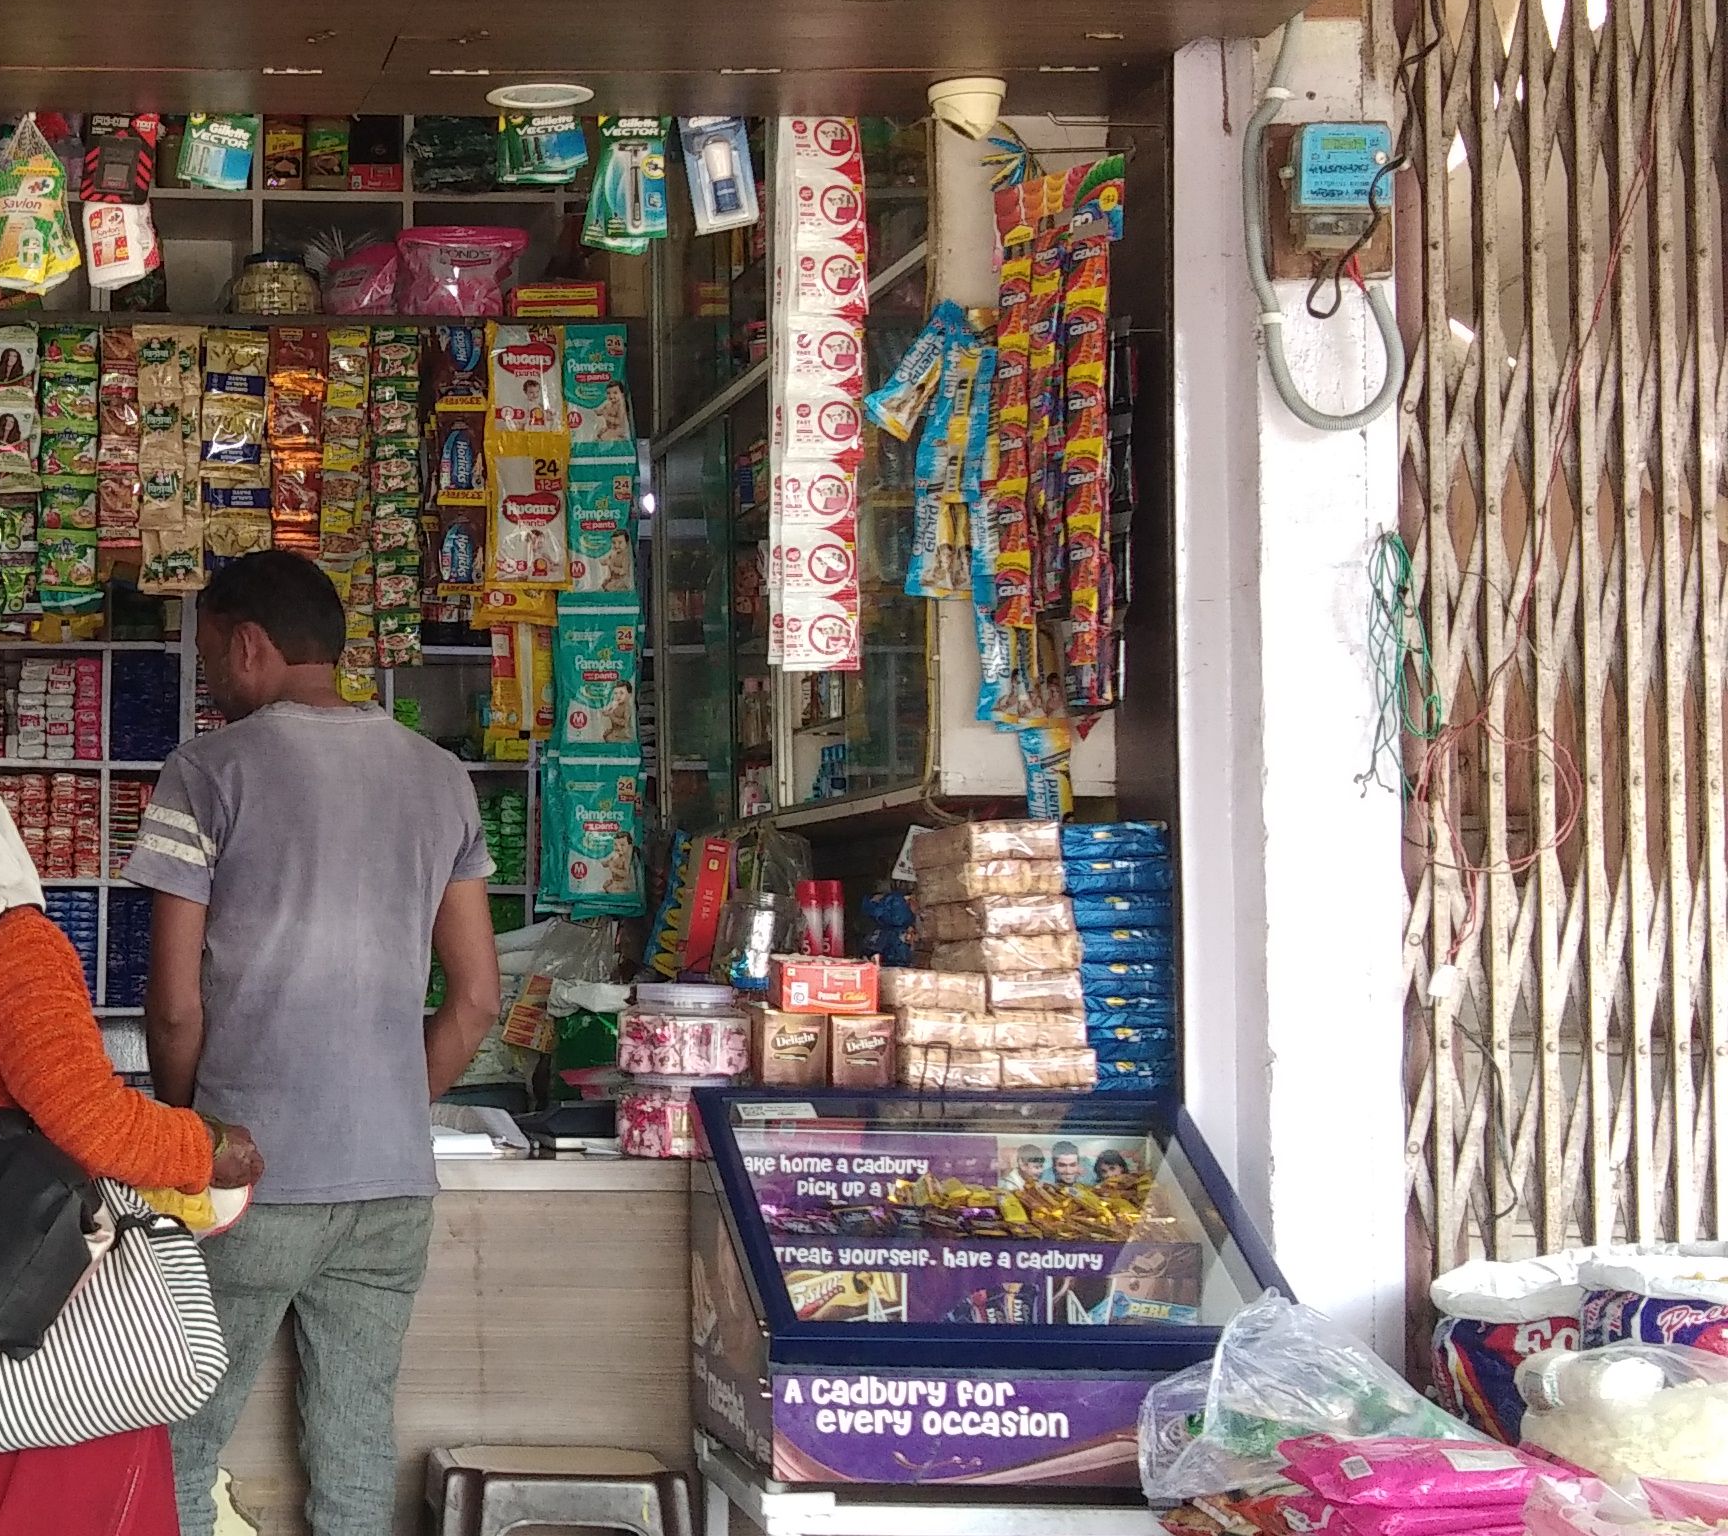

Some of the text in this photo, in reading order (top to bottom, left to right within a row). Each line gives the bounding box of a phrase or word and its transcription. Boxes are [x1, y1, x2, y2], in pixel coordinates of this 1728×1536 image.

[209, 123, 251, 140] Gillette
[517, 122, 576, 136] VECTOR
[603, 125, 660, 137] VECTOR
[191, 128, 249, 150] VECTOR
[1, 197, 43, 210] Savlon
[1070, 322, 1097, 335] GEMS
[502, 352, 552, 366] HUGGIES
[567, 358, 614, 373] Pampers
[896, 333, 936, 383] Gillette
[456, 441, 468, 484] Horlicks
[534, 458, 559, 476] 24
[614, 480, 630, 490] 24
[573, 505, 620, 521] Pampers
[457, 534, 470, 577] Horlicks
[617, 630, 633, 640] 24
[575, 655, 623, 671] Pampers
[576, 805, 624, 822] Pampers
[775, 1033, 816, 1048] Delight
[846, 1036, 886, 1052] Delight
[780, 1153, 831, 1174] home
[943, 1247, 991, 1267] have
[1130, 1302, 1170, 1318] PERK
[784, 1382, 802, 1405] A
[957, 1379, 1016, 1406] for
[816, 1405, 1069, 1438] every occasion
